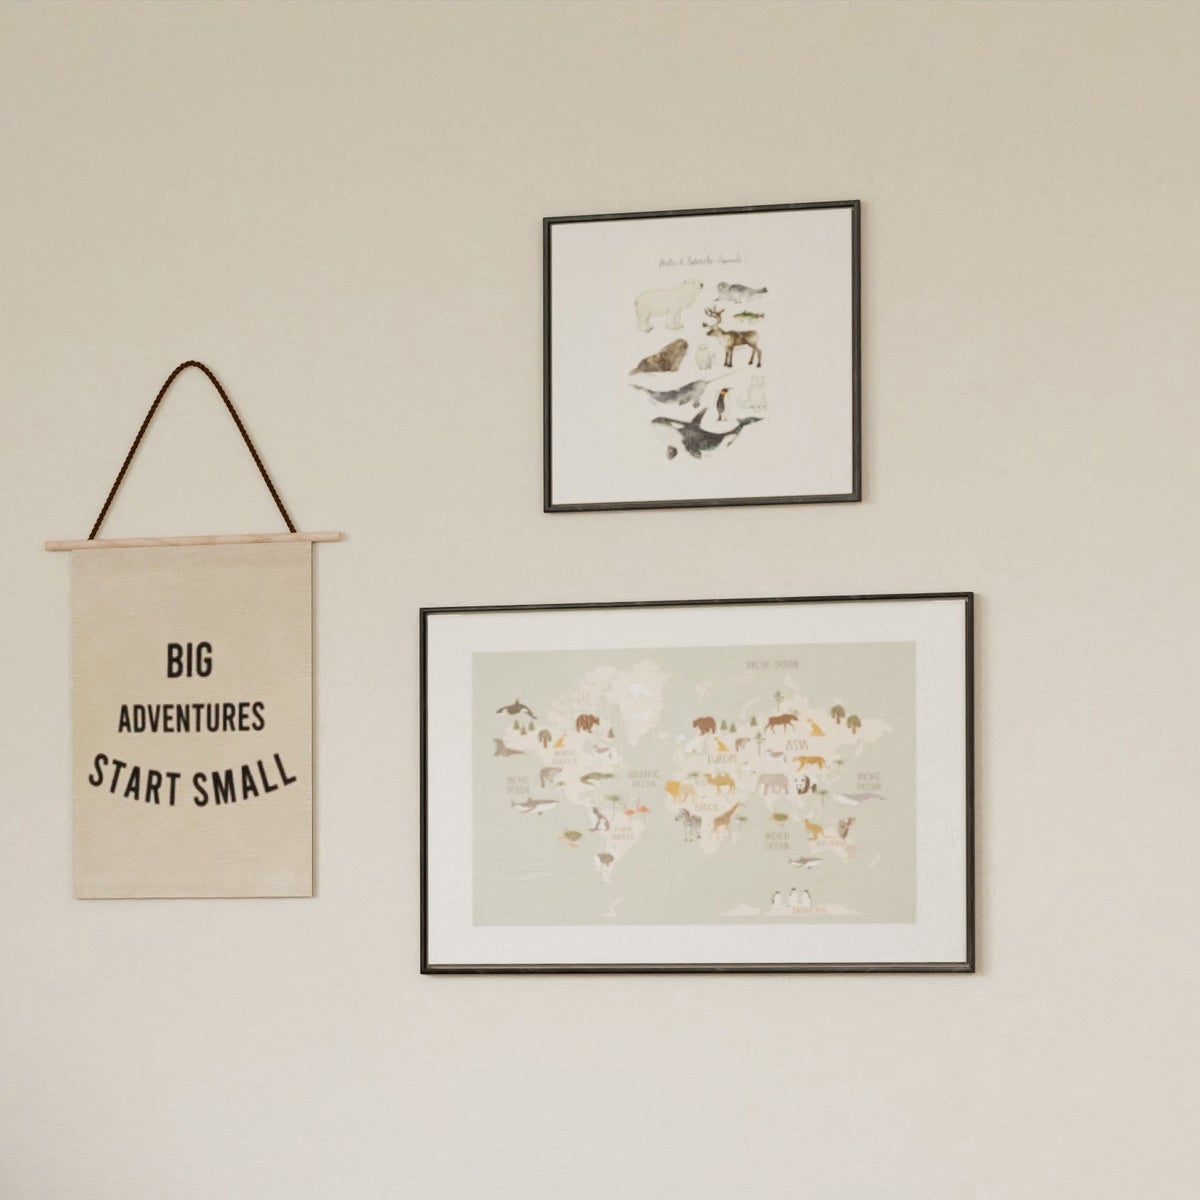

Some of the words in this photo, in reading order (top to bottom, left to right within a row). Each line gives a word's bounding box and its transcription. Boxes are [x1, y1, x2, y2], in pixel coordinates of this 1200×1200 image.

[168, 642, 212, 678] BIG
[119, 702, 264, 732] ADVENTURES
[89, 754, 180, 805] START
[193, 754, 296, 806] SMALL
